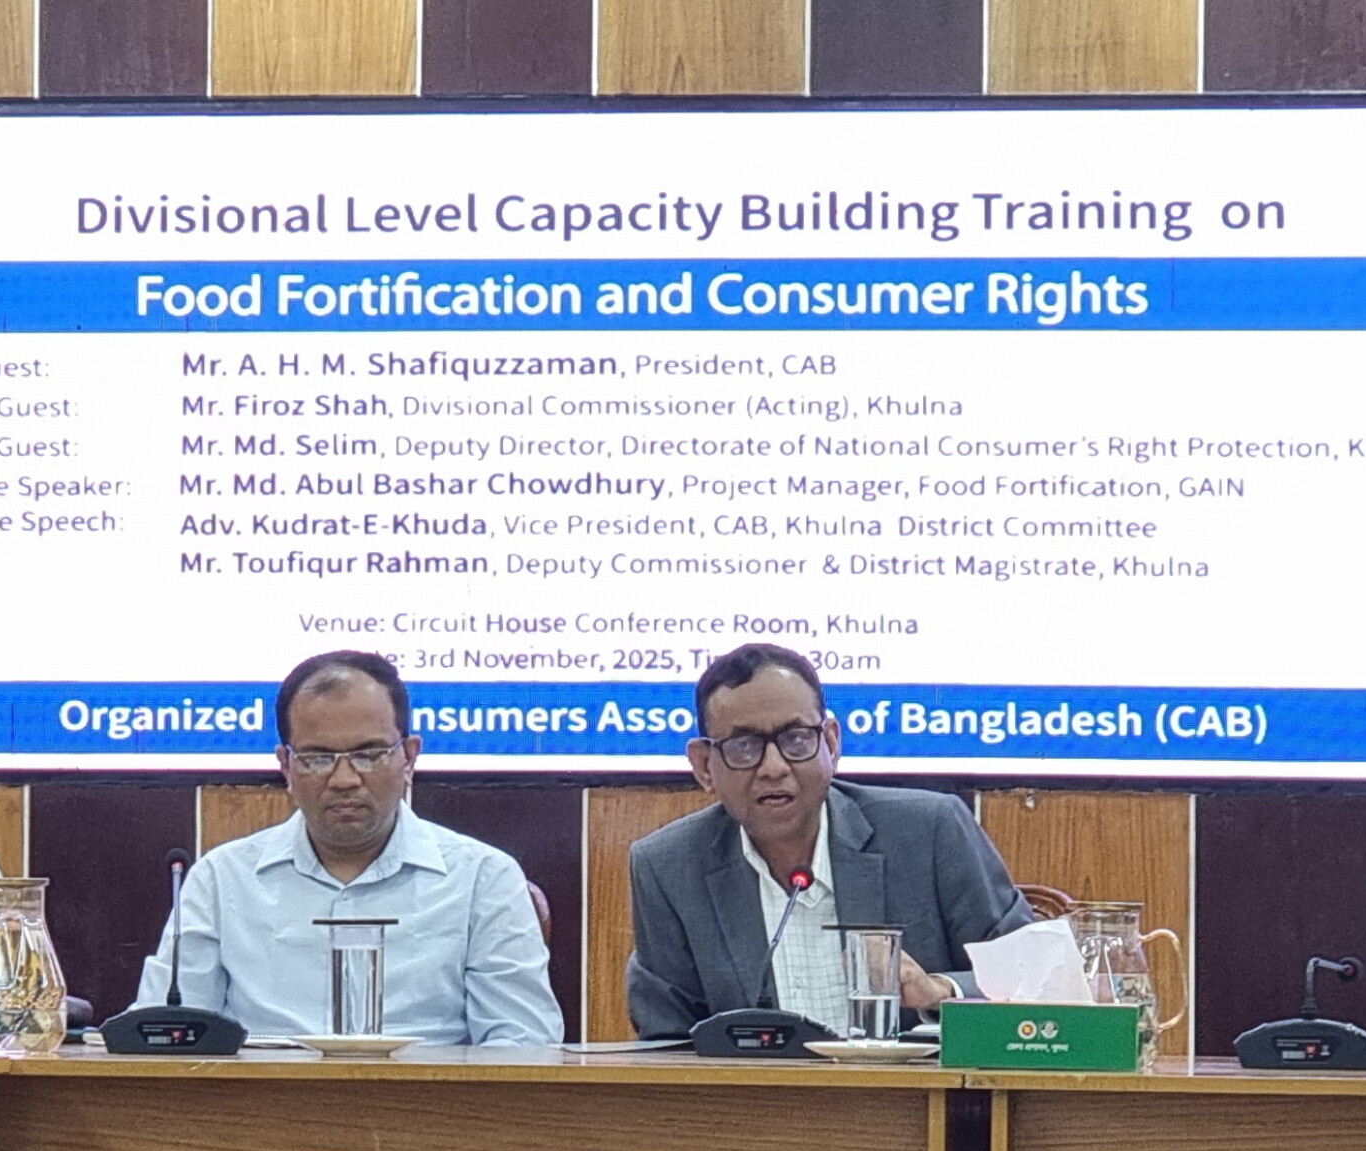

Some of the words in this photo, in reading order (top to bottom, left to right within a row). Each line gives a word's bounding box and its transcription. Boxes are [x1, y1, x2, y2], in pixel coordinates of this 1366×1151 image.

[77, 192, 328, 235] Divisional
[346, 192, 479, 234] Level
[495, 191, 724, 242] Capacity
[740, 190, 960, 243] Building
[971, 189, 1193, 243] Training
[1220, 200, 1285, 230] on
[137, 273, 261, 317] Food
[278, 271, 582, 317] Fortification
[596, 271, 692, 315] and
[707, 273, 974, 315] Consumer
[988, 270, 1148, 326] Rights
[182, 351, 227, 377] Mr.
[237, 353, 267, 377] A.
[278, 353, 310, 376] H.
[321, 352, 356, 376] M.
[367, 350, 626, 382] Shafiquzzaman,
[635, 354, 773, 379] President,
[781, 354, 837, 376] CAB
[182, 395, 224, 417] Mr.
[234, 393, 305, 417] Firoz
[314, 393, 394, 419] Shah,
[403, 394, 533, 416] Divisional
[542, 395, 736, 416] Commissioner
[746, 395, 858, 423] (Acting),
[867, 395, 963, 416] Khulna
[181, 434, 224, 457] Mr.
[234, 433, 285, 457] Md.
[295, 433, 386, 459] Selim,
[395, 435, 490, 461] Deputy
[499, 435, 612, 459] Director,
[621, 435, 772, 457] Directorate
[779, 433, 806, 457] of
[814, 435, 929, 457] National
[1108, 436, 1178, 464] Right
[1188, 437, 1339, 461] Protection,
[17, 475, 131, 502] Speaker:
[179, 473, 222, 496] Mr.
[233, 472, 286, 496] Md.
[295, 472, 364, 496] Abul
[373, 471, 479, 496] Bashar
[486, 471, 673, 501] Chowdhury,
[682, 474, 777, 501] Project
[787, 475, 910, 502] Manager,
[919, 475, 986, 497] Food
[995, 474, 1170, 502] Fortification,
[1178, 476, 1244, 498] GAIN
[21, 510, 124, 537] Speech:
[179, 513, 242, 536] Adv.
[252, 512, 495, 539] Kudrat-E-Khuda,
[503, 514, 559, 536] Vice
[567, 514, 705, 539] President,
[713, 514, 776, 539] CAB,
[786, 514, 882, 537] Khulna
[898, 515, 994, 537] District
[1003, 516, 1157, 538] Committee
[180, 551, 222, 574] Mr.
[231, 550, 358, 579] Toufiqur
[366, 549, 498, 577] Rahman,
[506, 553, 603, 579] Deputy
[610, 552, 807, 575] Commissioner
[822, 554, 841, 575] &
[850, 553, 946, 576] District
[955, 555, 1104, 582] Magistrate,
[1113, 555, 1209, 578] Khulna
[298, 614, 385, 633] Venue:
[392, 612, 477, 633] Circuit
[485, 613, 567, 634] House
[575, 611, 725, 634] Conference
[733, 613, 818, 638] Room,
[826, 614, 919, 635] Khulna
[414, 648, 455, 669] 3rd
[463, 645, 606, 673] November,
[612, 648, 683, 674] 2025,
[809, 650, 881, 670] 30am
[59, 698, 264, 740] Organized
[411, 706, 589, 732] nsumers
[847, 700, 892, 734] of
[901, 701, 1142, 744] Bangladesh
[1155, 703, 1267, 744] (CAB)
